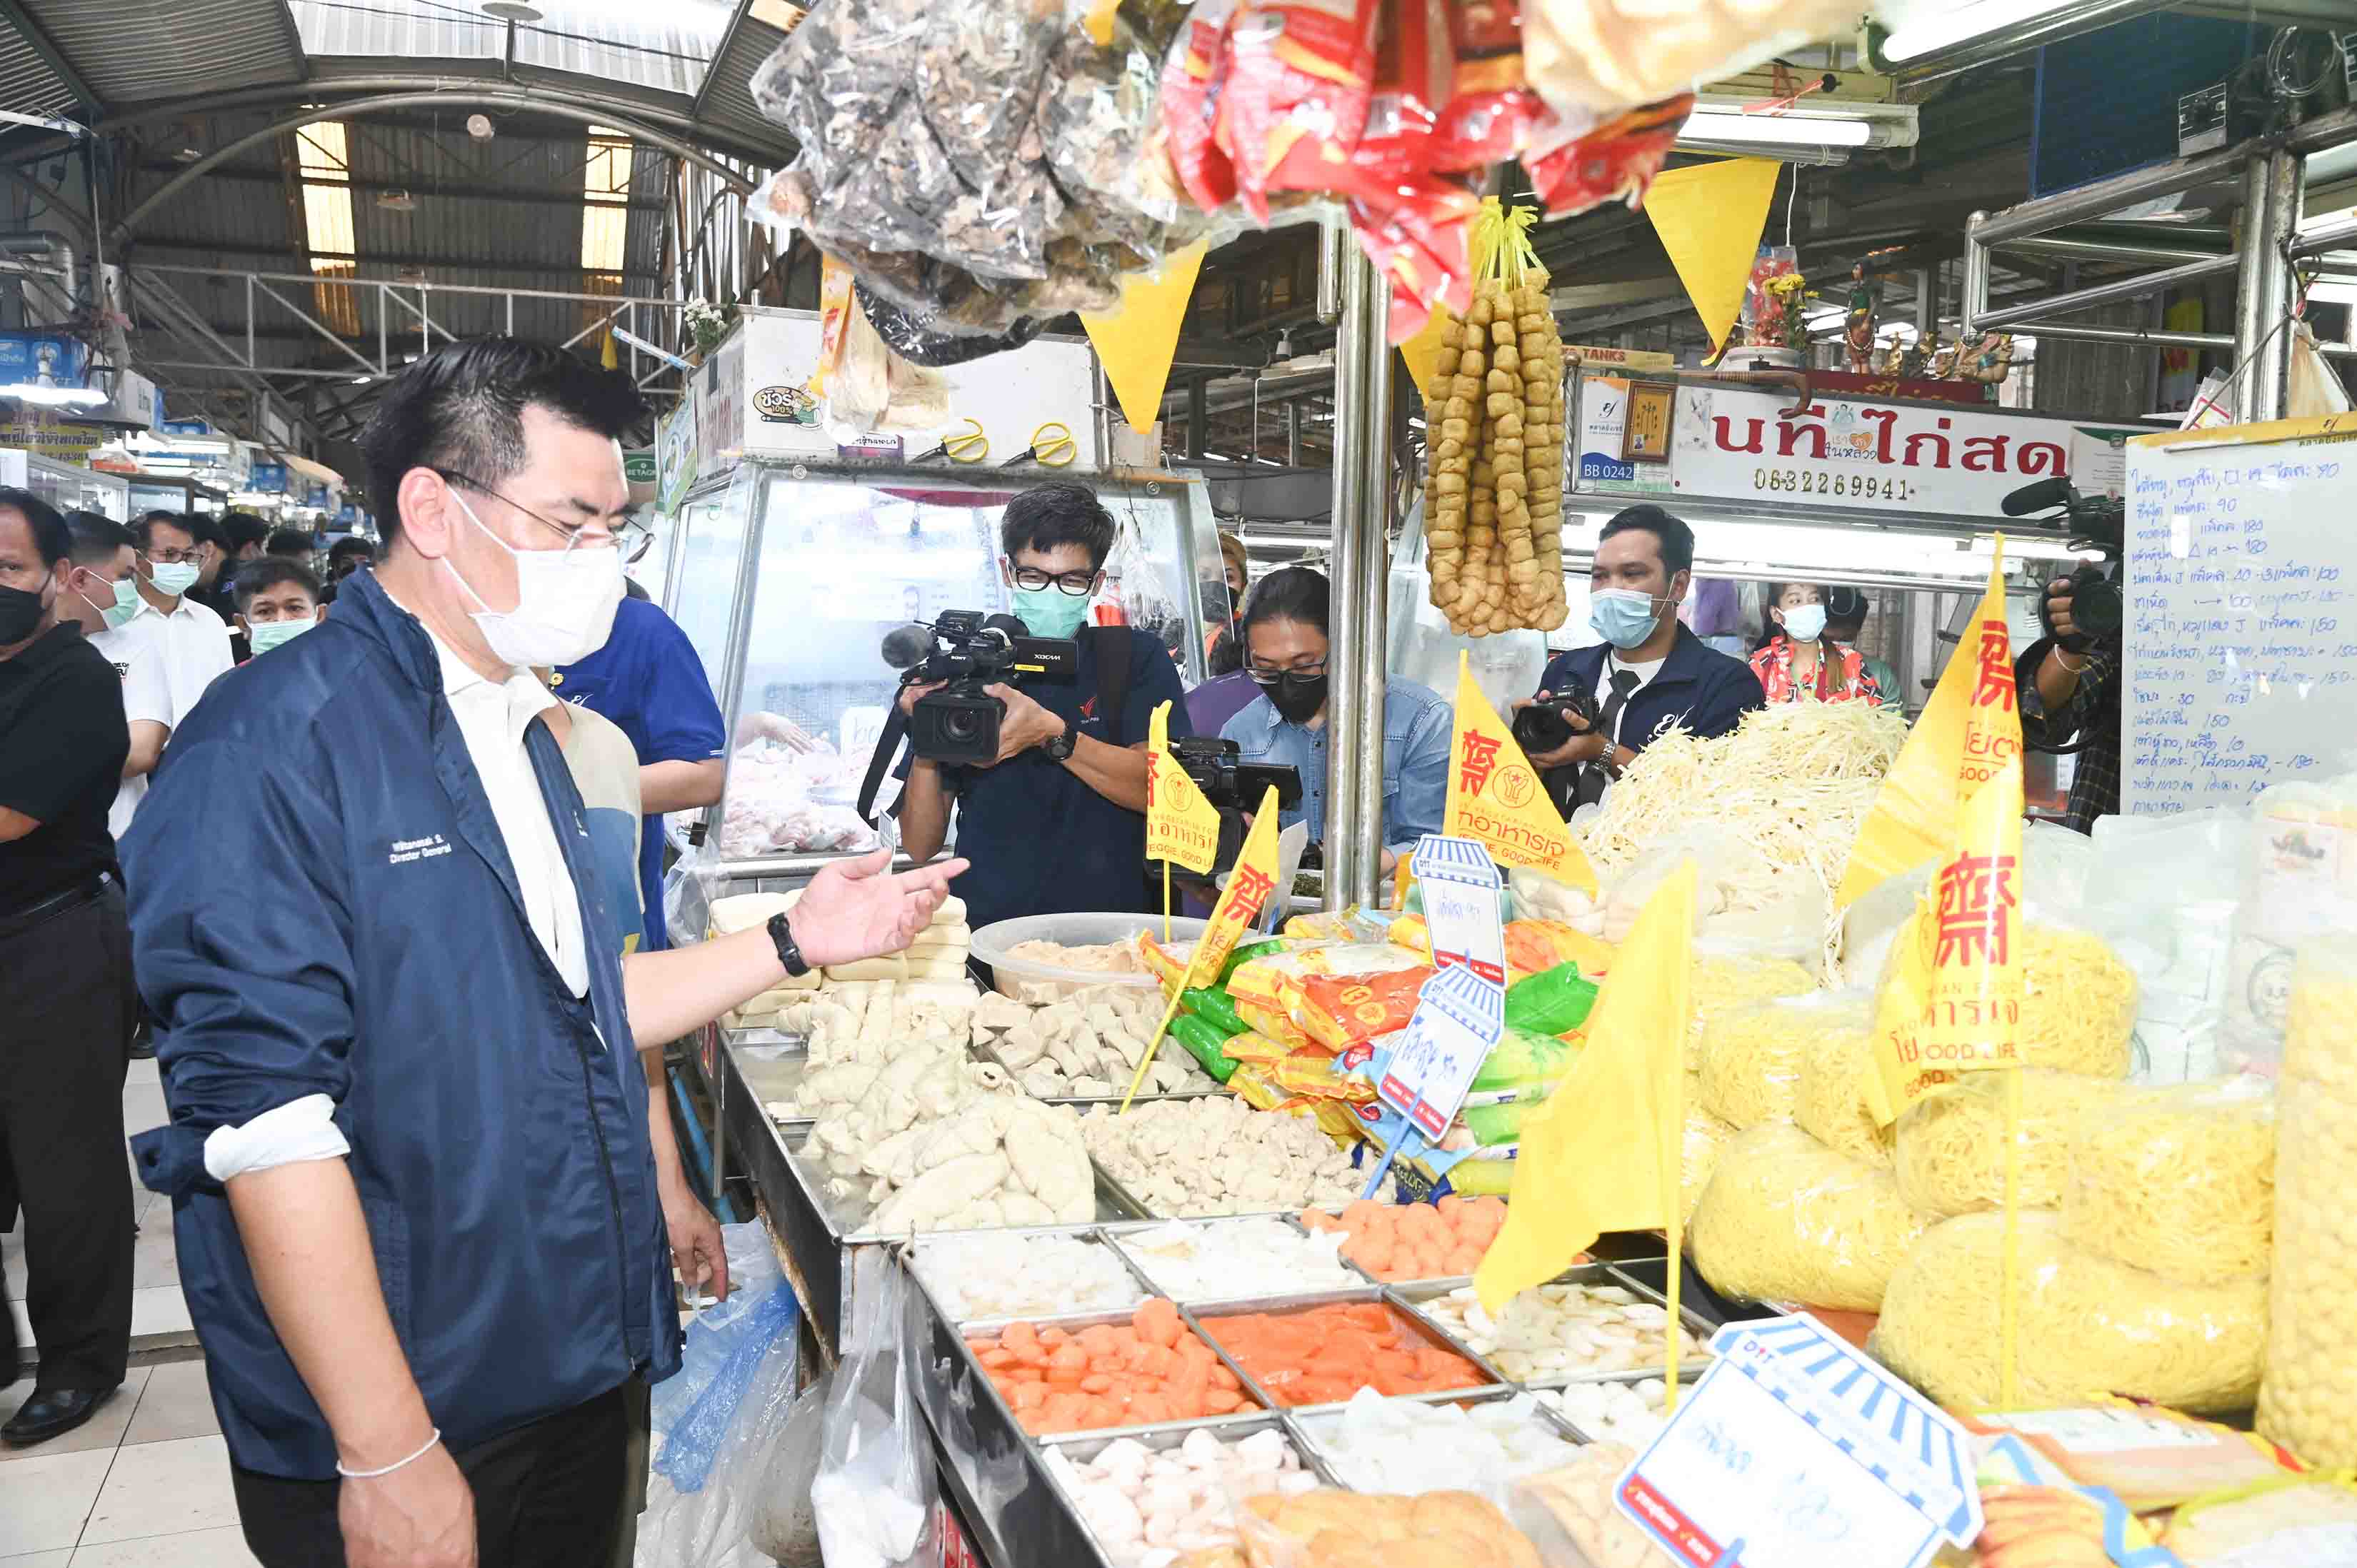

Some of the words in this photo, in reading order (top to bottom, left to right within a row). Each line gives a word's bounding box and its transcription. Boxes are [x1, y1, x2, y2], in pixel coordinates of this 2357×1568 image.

[1583, 348, 1626, 362] TANKS
[771, 405, 794, 415] 100%
[1861, 408, 2068, 477] ไก่สด
[1583, 463, 1600, 478] BB
[1602, 464, 1633, 479] 0242
